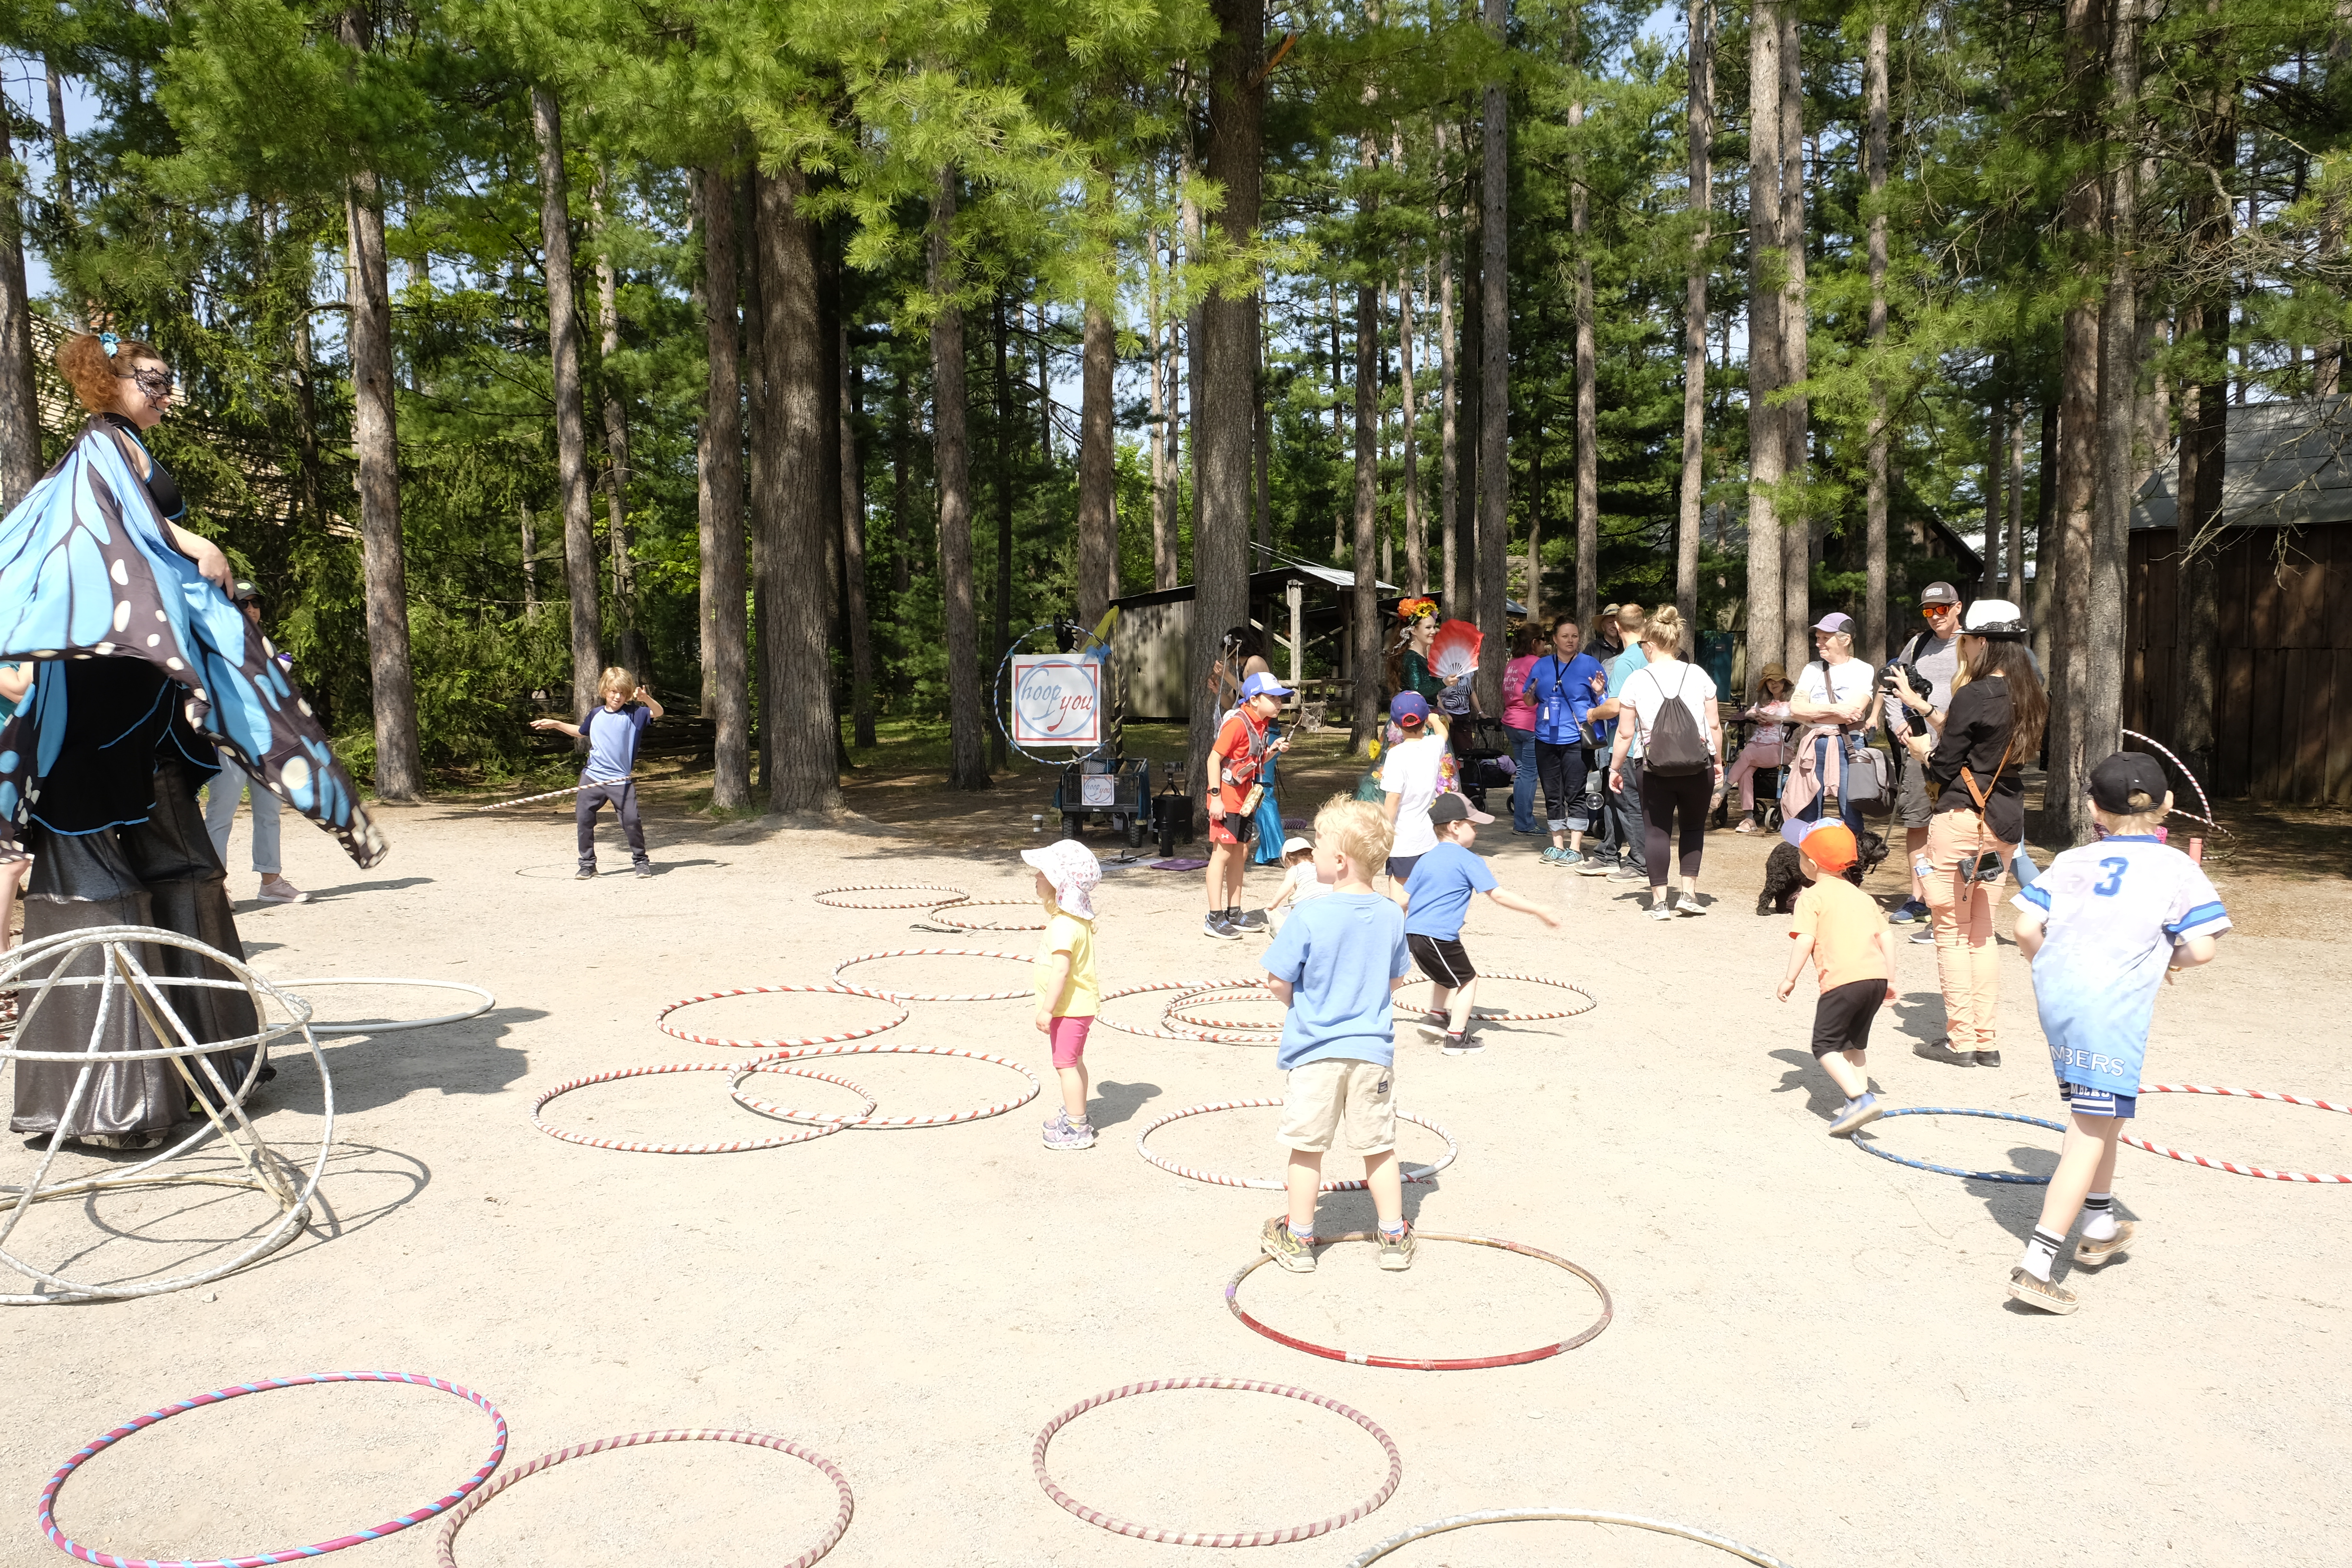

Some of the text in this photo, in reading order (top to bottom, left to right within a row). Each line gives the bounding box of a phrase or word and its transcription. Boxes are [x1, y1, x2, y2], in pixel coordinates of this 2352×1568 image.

[1021, 668, 1093, 732] hoop you
[1085, 778, 1111, 800] hoop you
[2093, 857, 2129, 897] 3
